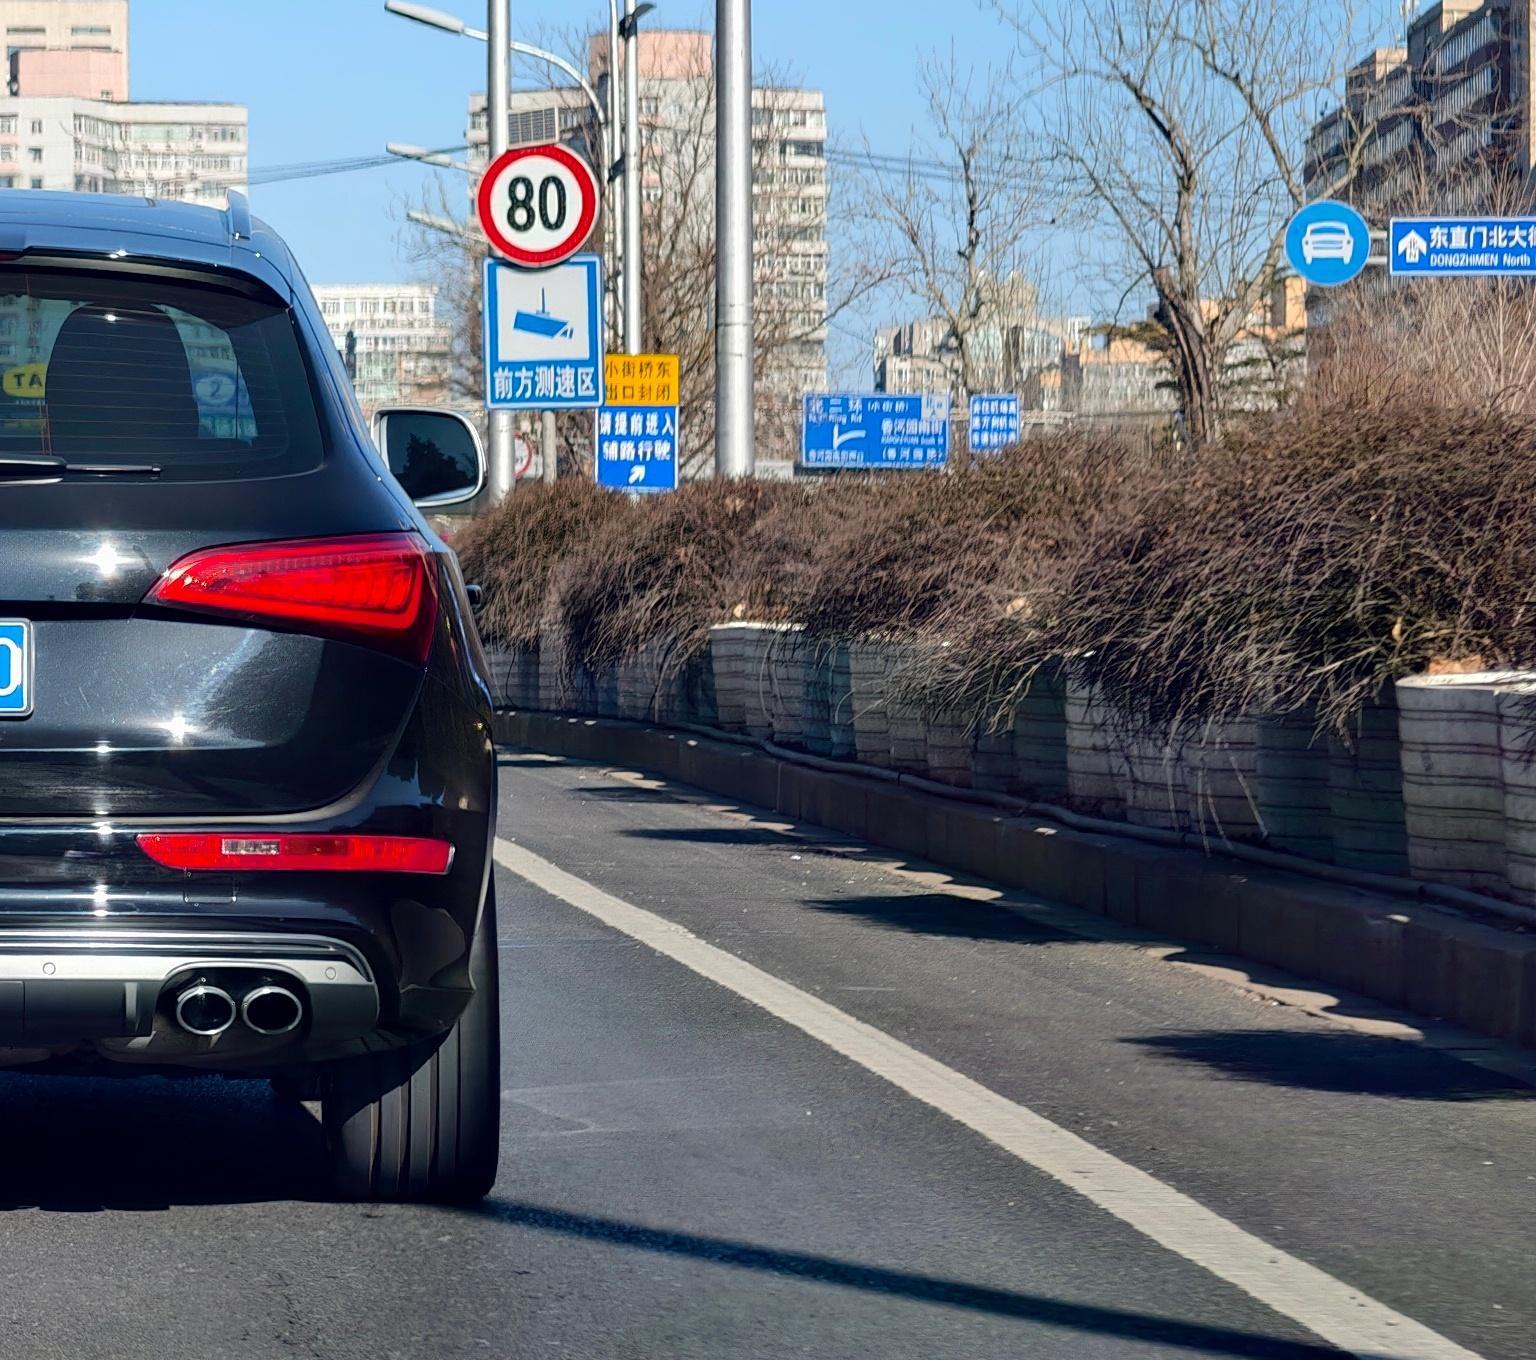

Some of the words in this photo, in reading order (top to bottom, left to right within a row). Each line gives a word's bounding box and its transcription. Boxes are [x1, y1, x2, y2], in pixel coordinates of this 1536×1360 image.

[507, 175, 566, 232] 80
[1430, 252, 1498, 267] DONGZHIMEN
[1503, 253, 1530, 267] North
[605, 360, 671, 379] 小街桥东
[494, 366, 596, 401] 前方测速区
[606, 383, 670, 401] 出口封闭
[600, 411, 674, 436] 请提前进入
[602, 440, 671, 461] 辅路行驶
